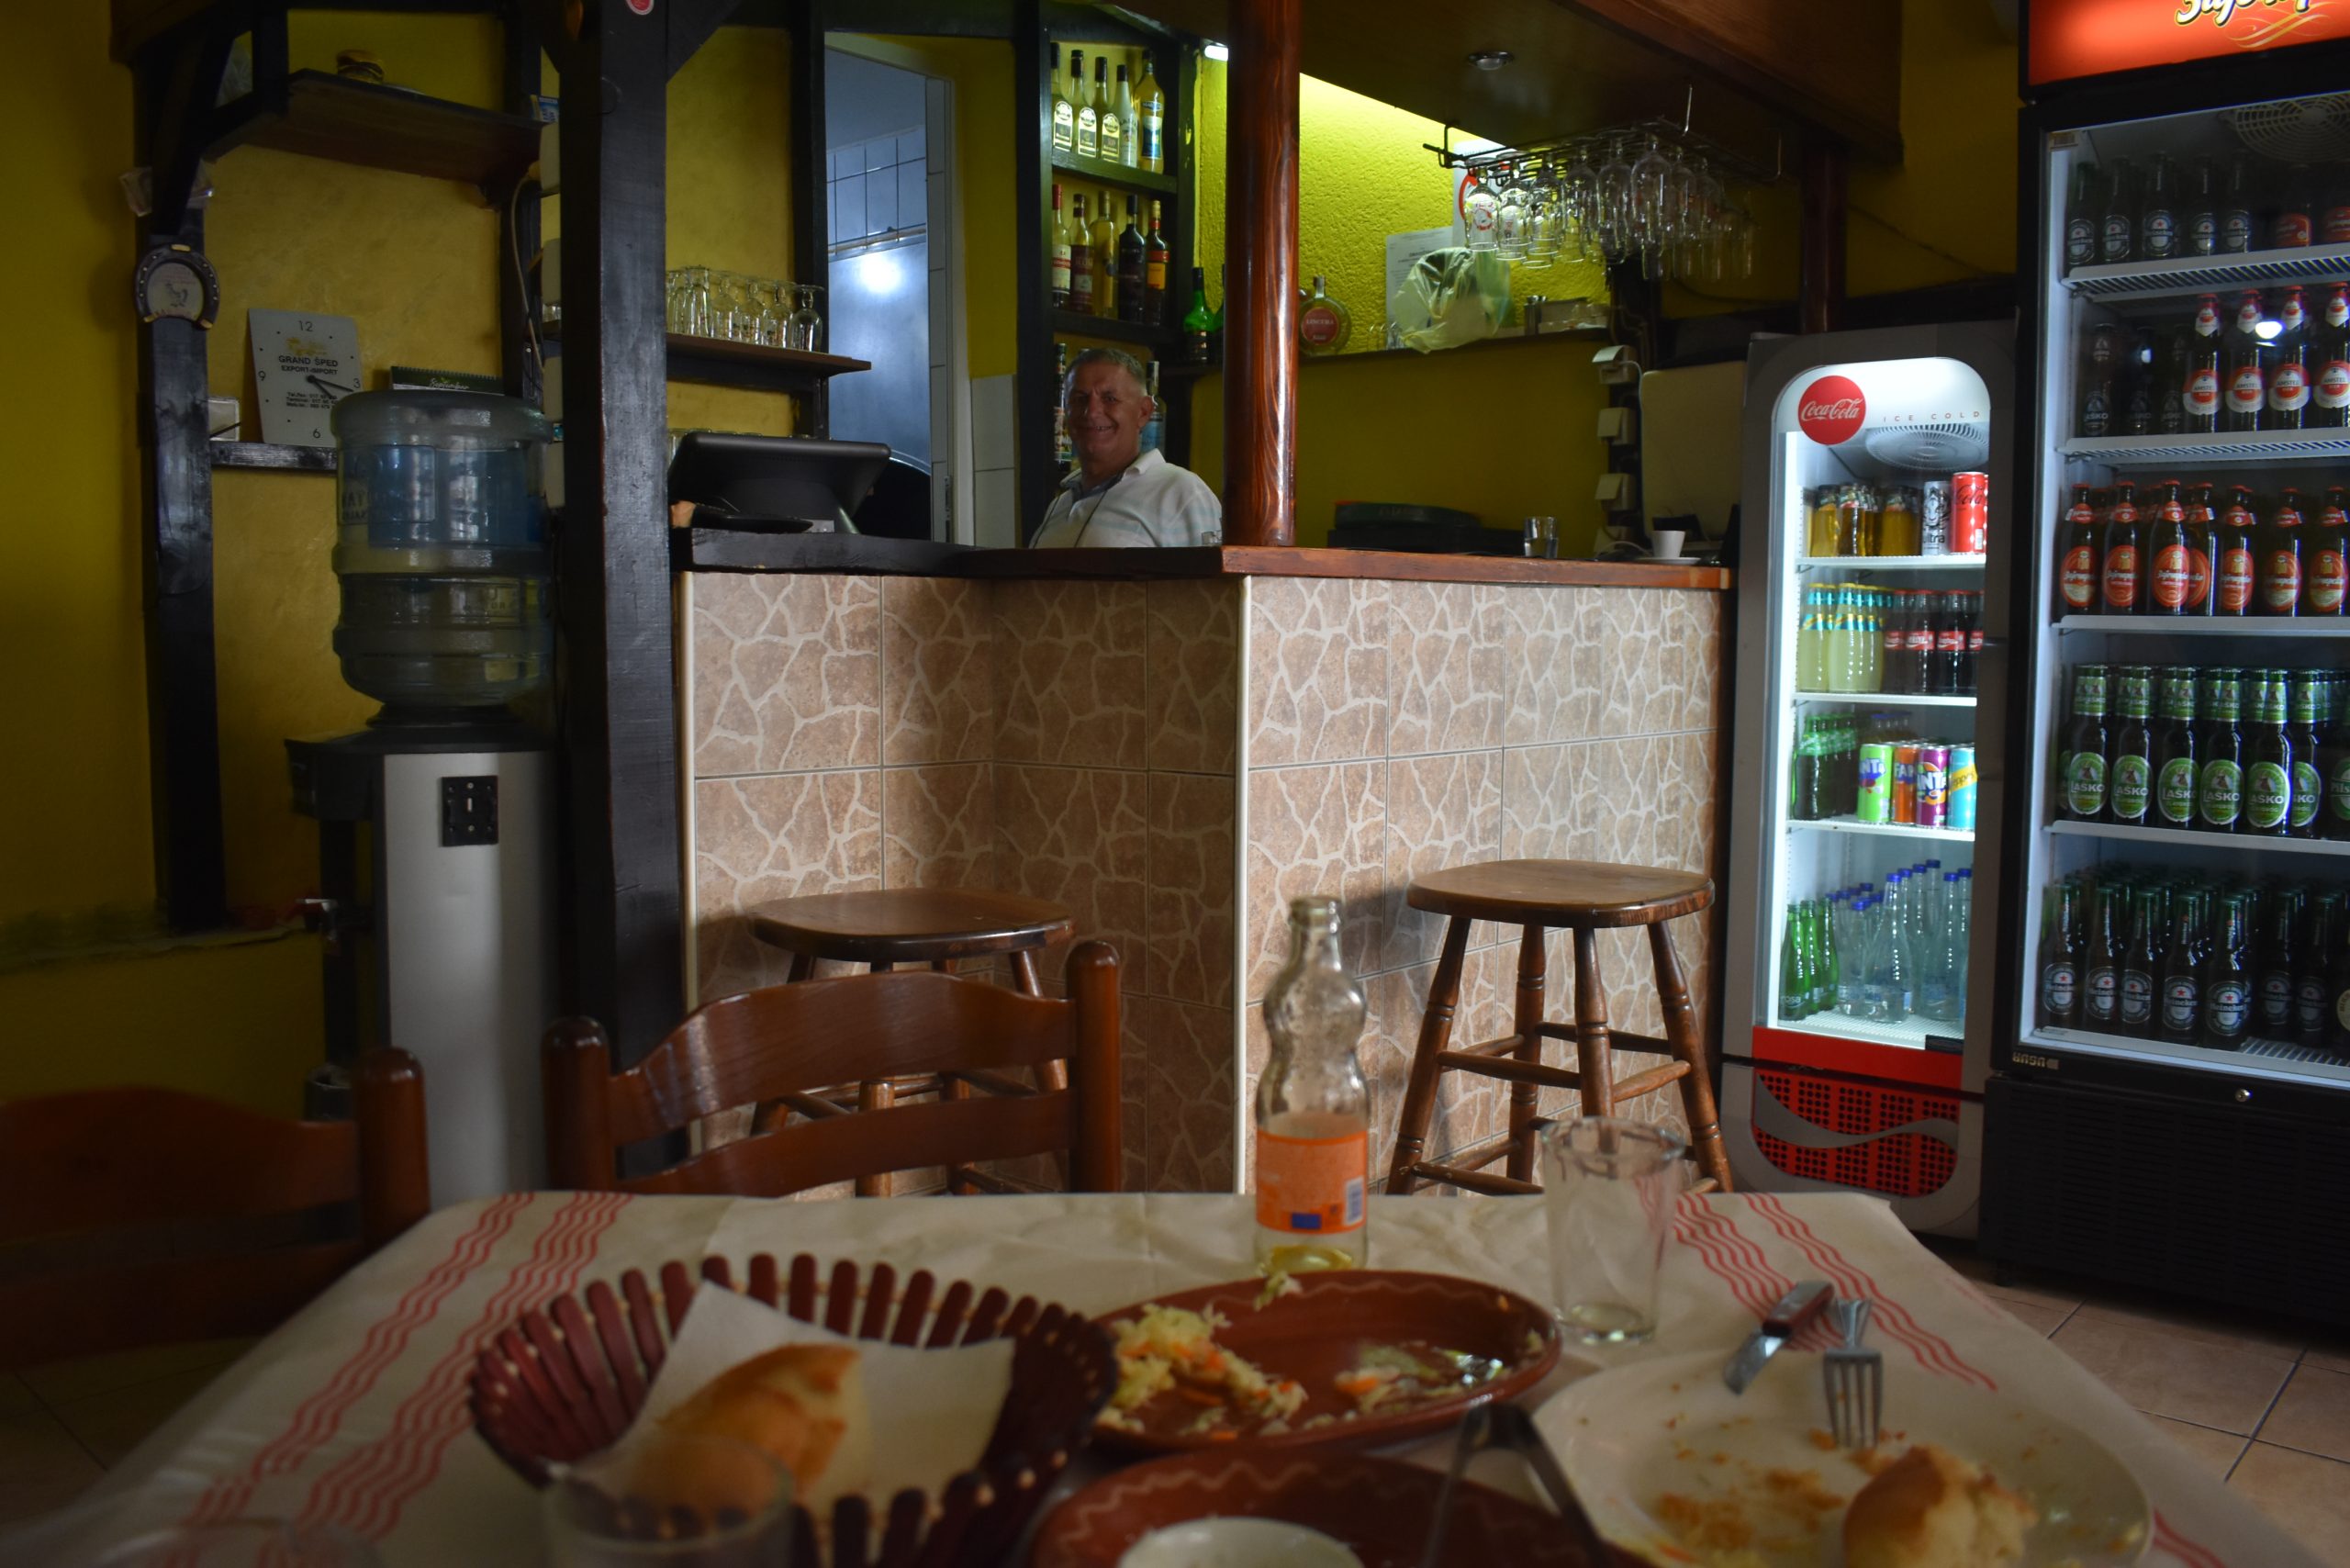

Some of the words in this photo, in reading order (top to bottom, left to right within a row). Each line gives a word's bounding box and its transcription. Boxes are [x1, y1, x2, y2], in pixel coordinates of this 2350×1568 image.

[298, 320, 314, 332] 12
[278, 354, 311, 364] GRAND
[281, 364, 338, 375] EXPORT-IMPORT
[258, 371, 266, 382] 9
[353, 377, 361, 389] 3
[1801, 398, 1863, 421] Coca-Cola
[1884, 414, 1914, 422] ICE
[1931, 410, 1980, 420] COLD
[313, 428, 320, 439] 6
